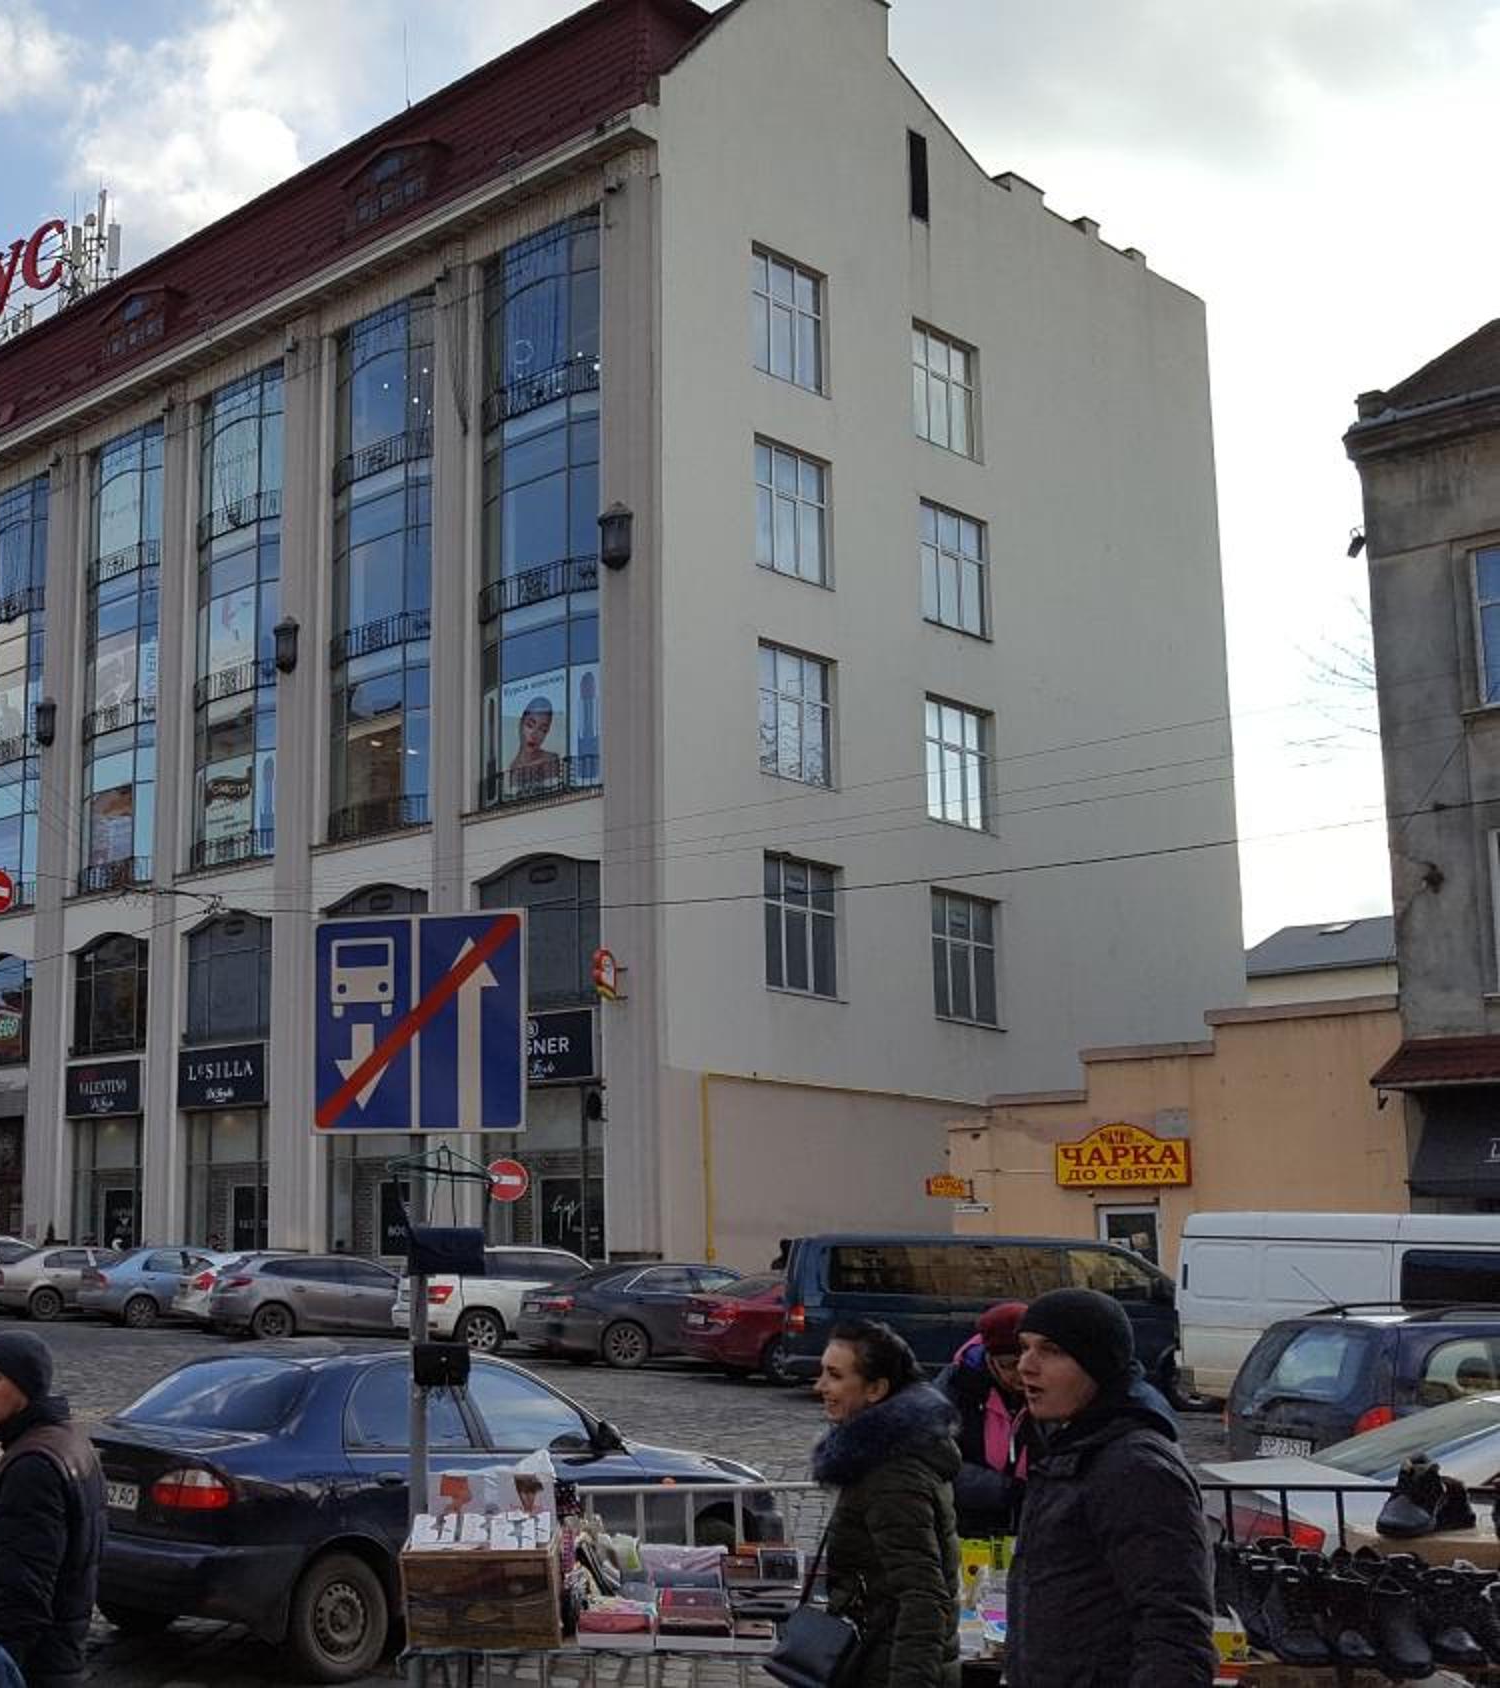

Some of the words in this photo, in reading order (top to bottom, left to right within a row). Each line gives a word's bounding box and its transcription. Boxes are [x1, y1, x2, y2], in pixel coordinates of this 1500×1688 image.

[1060, 1144, 1181, 1167] ЧАРКА
[1067, 1169, 1097, 1181] ДО
[1105, 1167, 1177, 1181] СВЯТА
